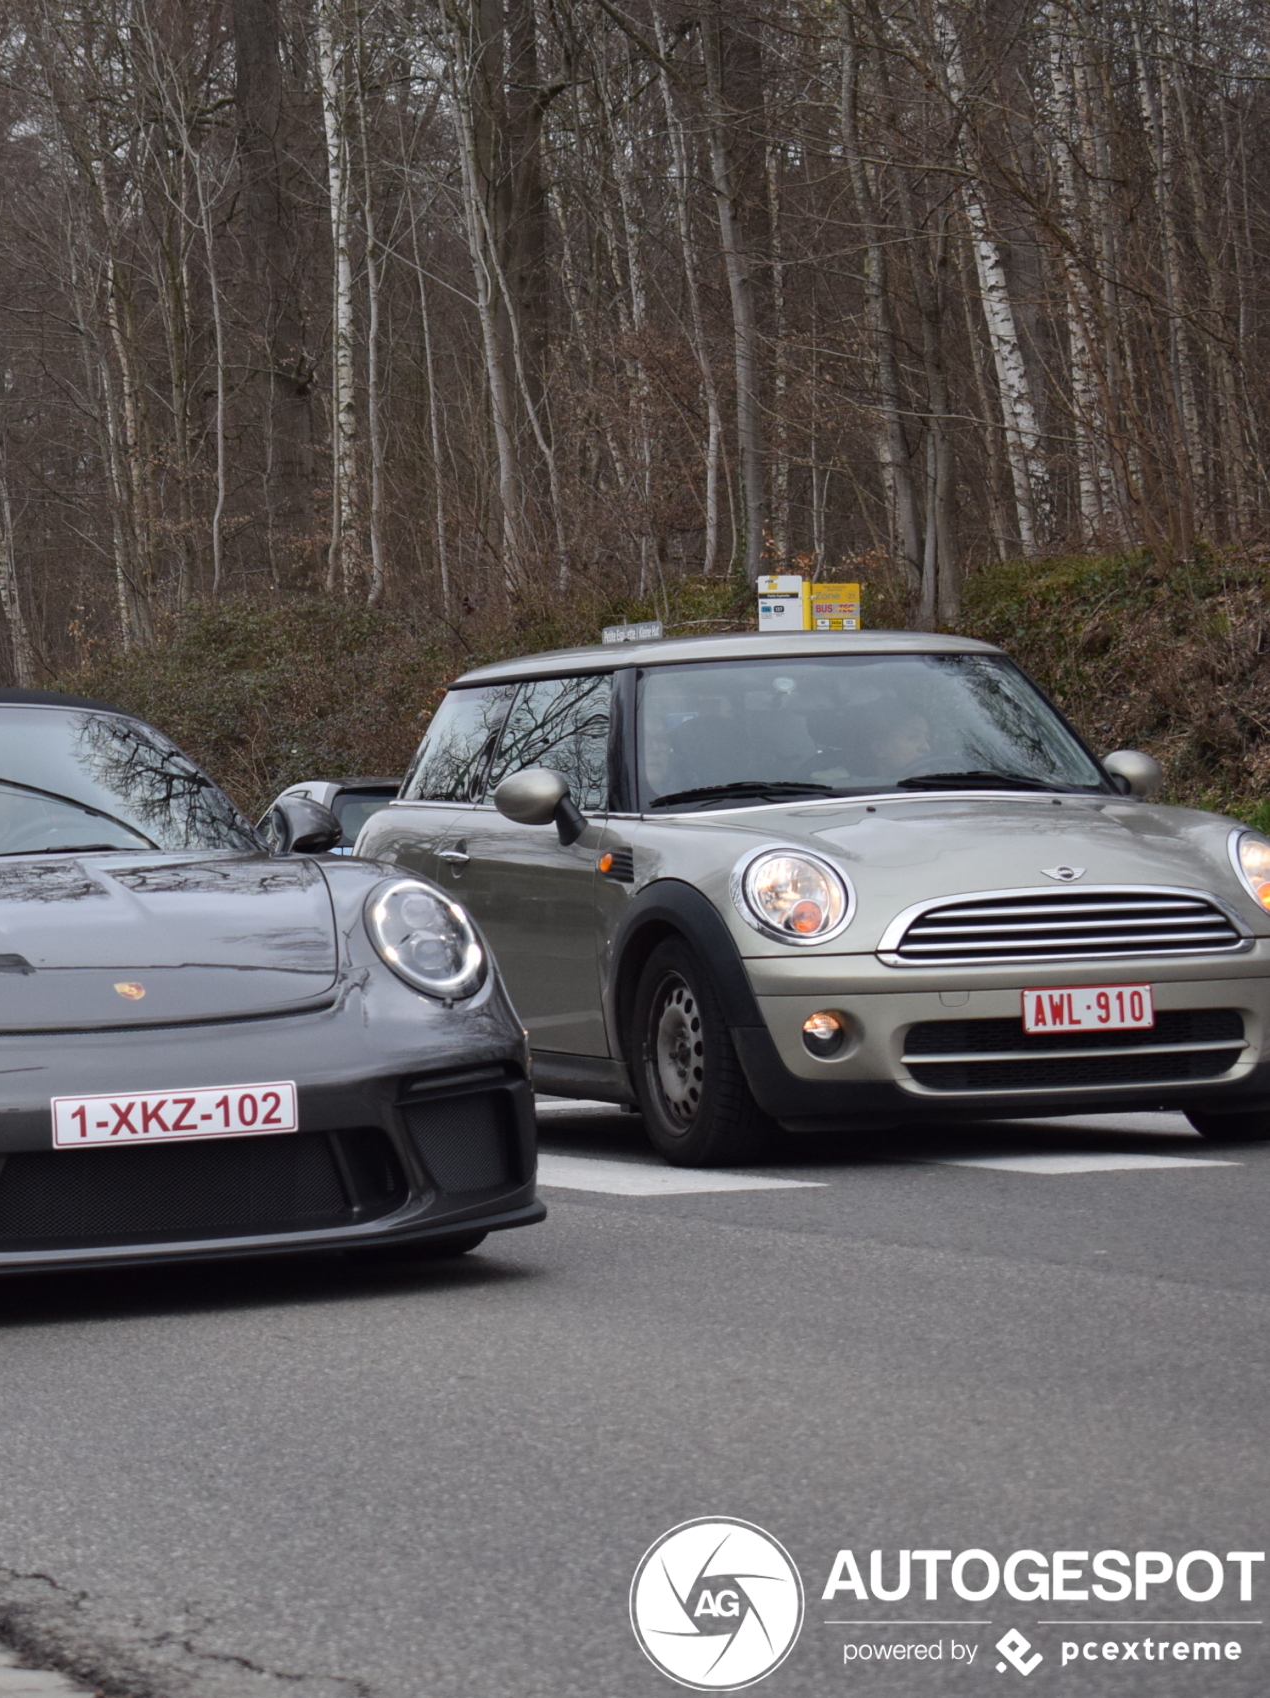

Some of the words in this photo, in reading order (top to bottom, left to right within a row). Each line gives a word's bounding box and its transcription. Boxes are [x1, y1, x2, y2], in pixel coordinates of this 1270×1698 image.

[816, 604, 833, 613] BUS
[839, 604, 855, 613] TEC
[71, 1092, 282, 1138] 1-XKZ-102
